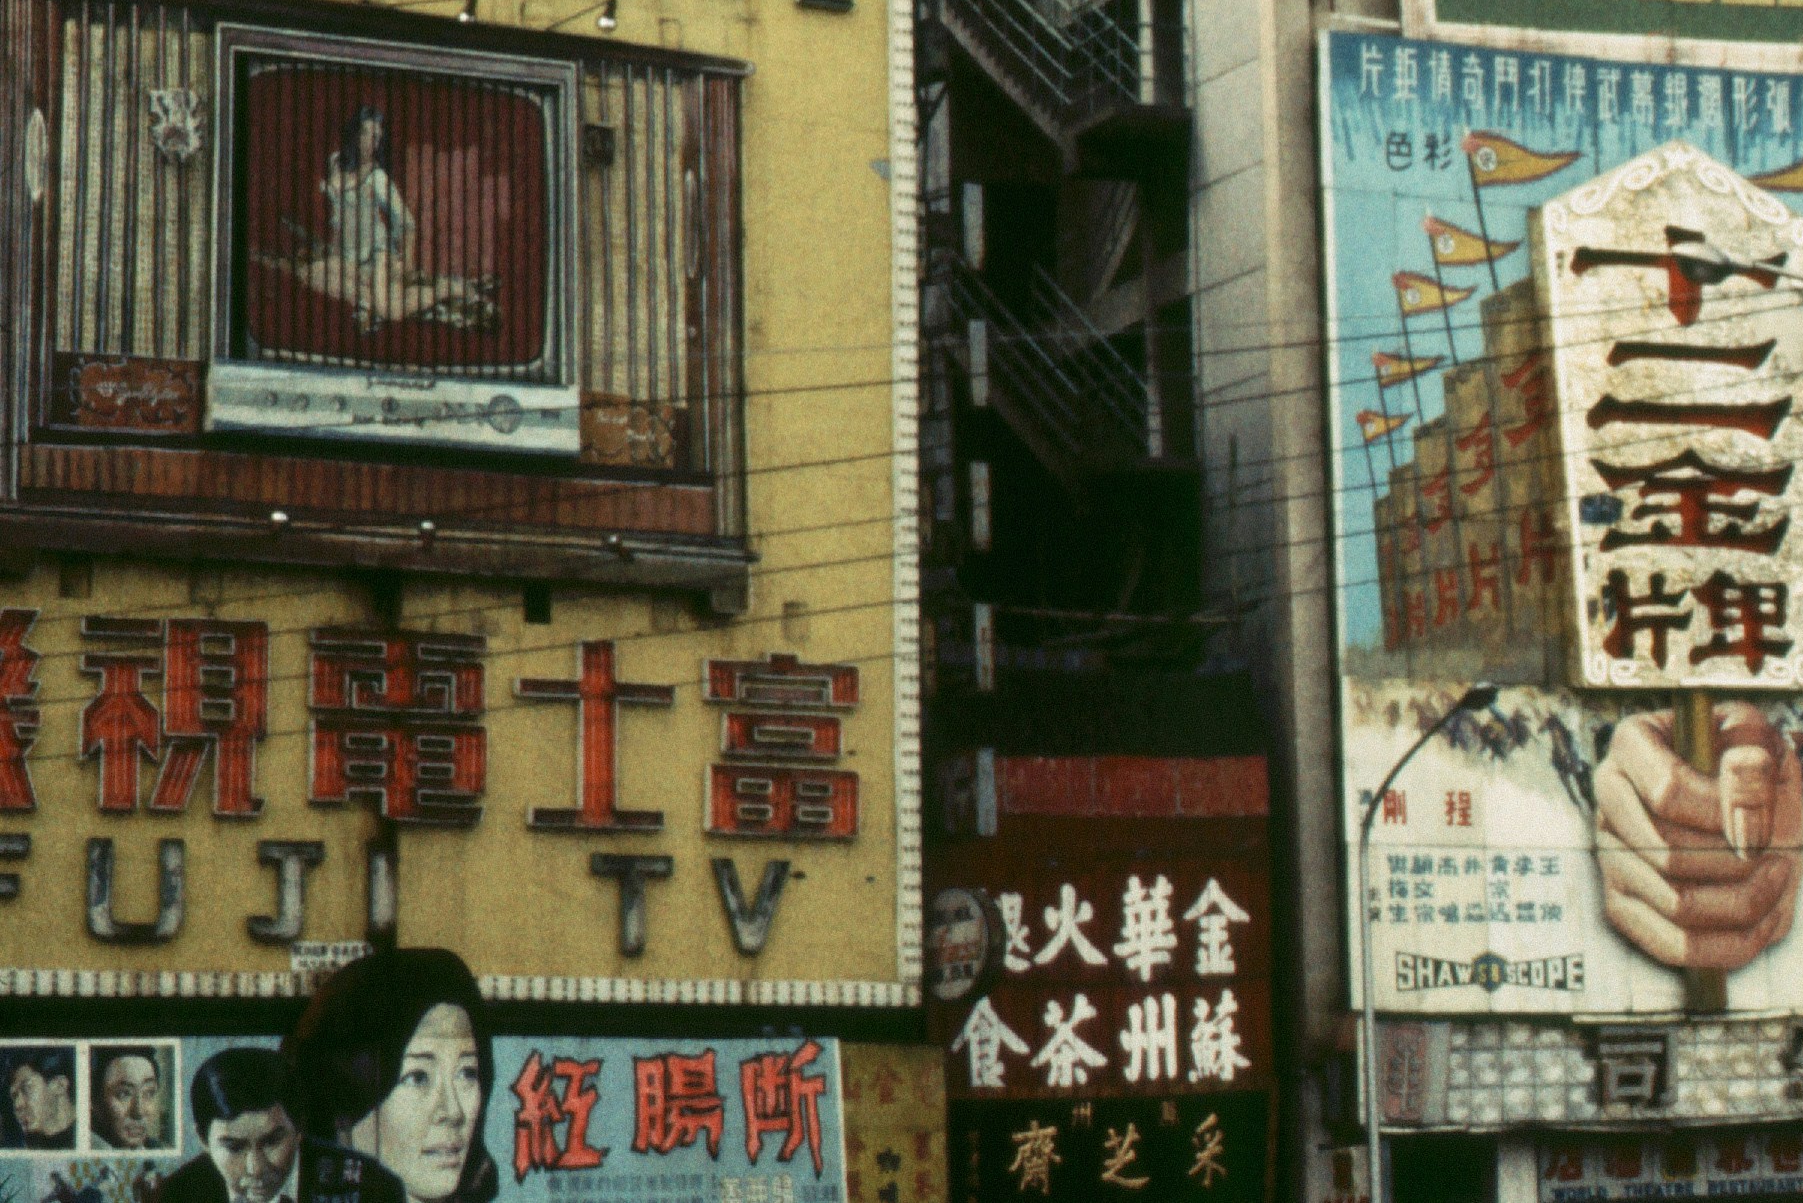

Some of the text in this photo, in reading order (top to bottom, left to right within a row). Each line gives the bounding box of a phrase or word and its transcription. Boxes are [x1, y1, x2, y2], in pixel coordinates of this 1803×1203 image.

[1568, 224, 1797, 676] 十二金牌
[0, 608, 862, 840] 富士電視
[590, 850, 792, 958] TV
[951, 988, 1252, 1089] 蘇州茶食
